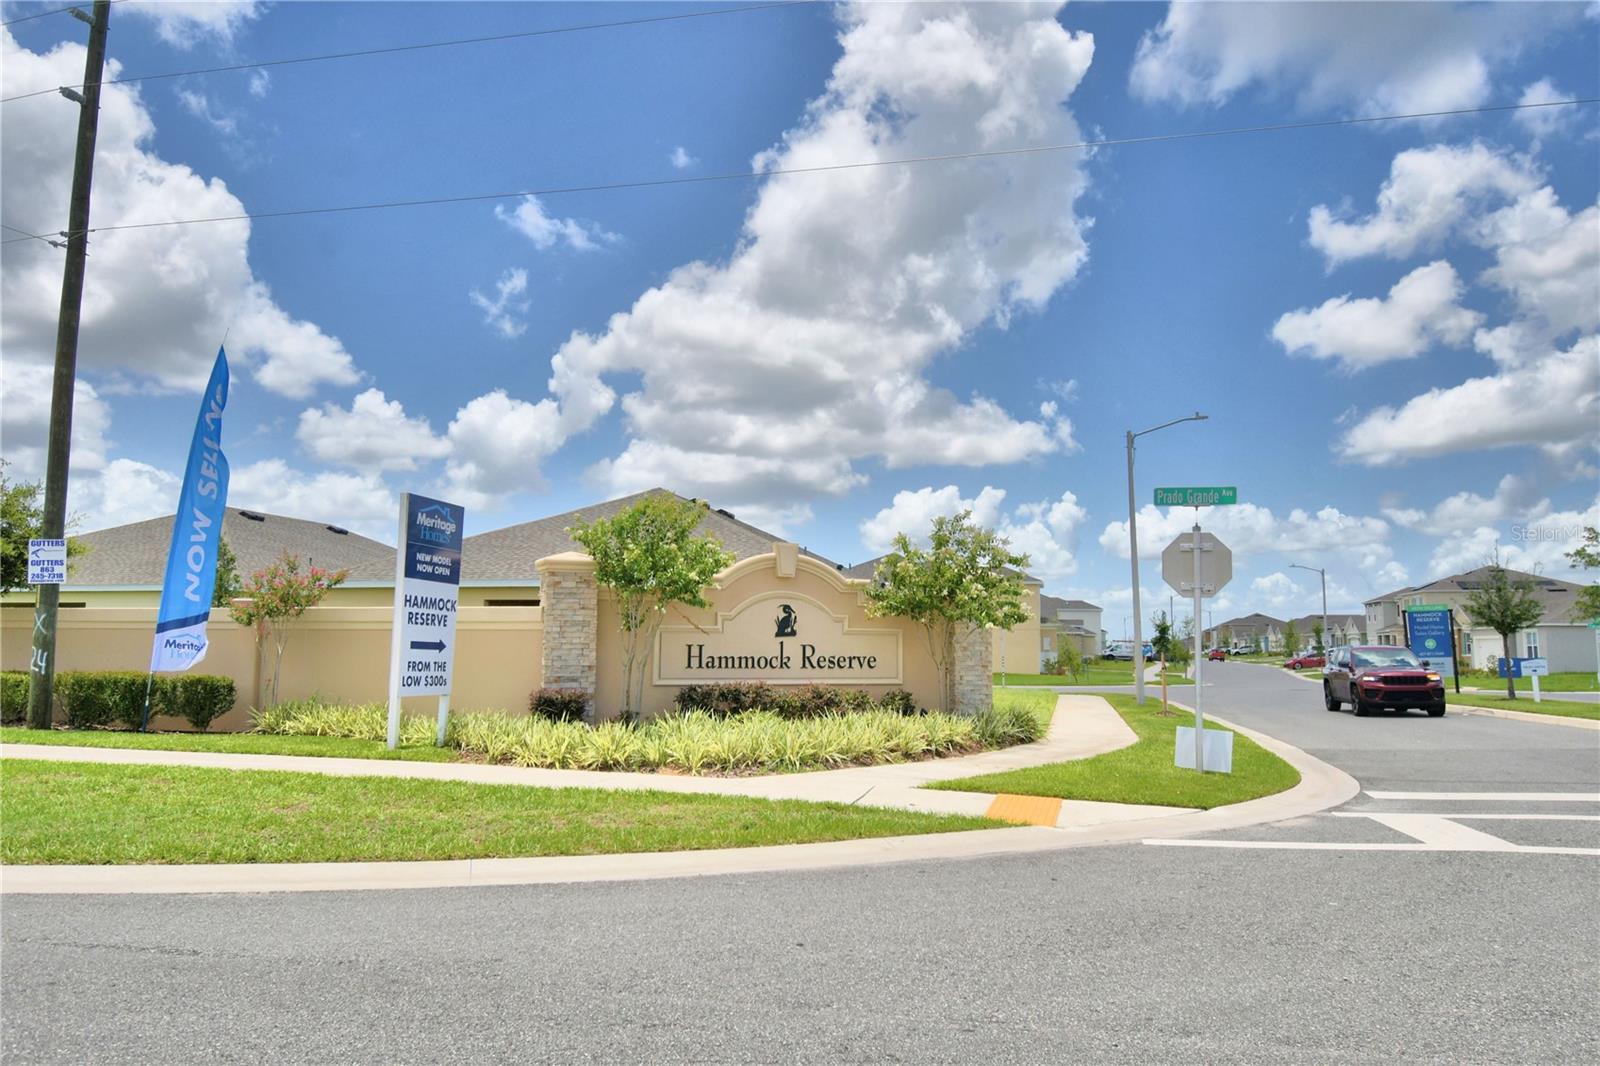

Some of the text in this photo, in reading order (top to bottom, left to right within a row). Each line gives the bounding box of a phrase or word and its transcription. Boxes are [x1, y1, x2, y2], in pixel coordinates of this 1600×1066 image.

[1157, 490, 1183, 503] Prado
[1187, 489, 1219, 503] Grande
[416, 512, 456, 534] Meritage
[421, 527, 449, 544] Homes
[183, 508, 212, 602] NOW
[416, 553, 452, 566] NEW MODEL
[416, 563, 451, 576] NOW OPEN
[404, 594, 457, 613] HAMMOCK
[407, 611, 448, 628] RESERVE
[164, 639, 206, 651] Merita
[685, 641, 877, 669] Hammock Reserve
[407, 661, 447, 672] FROM THE
[402, 676, 447, 687] LOW $300s
